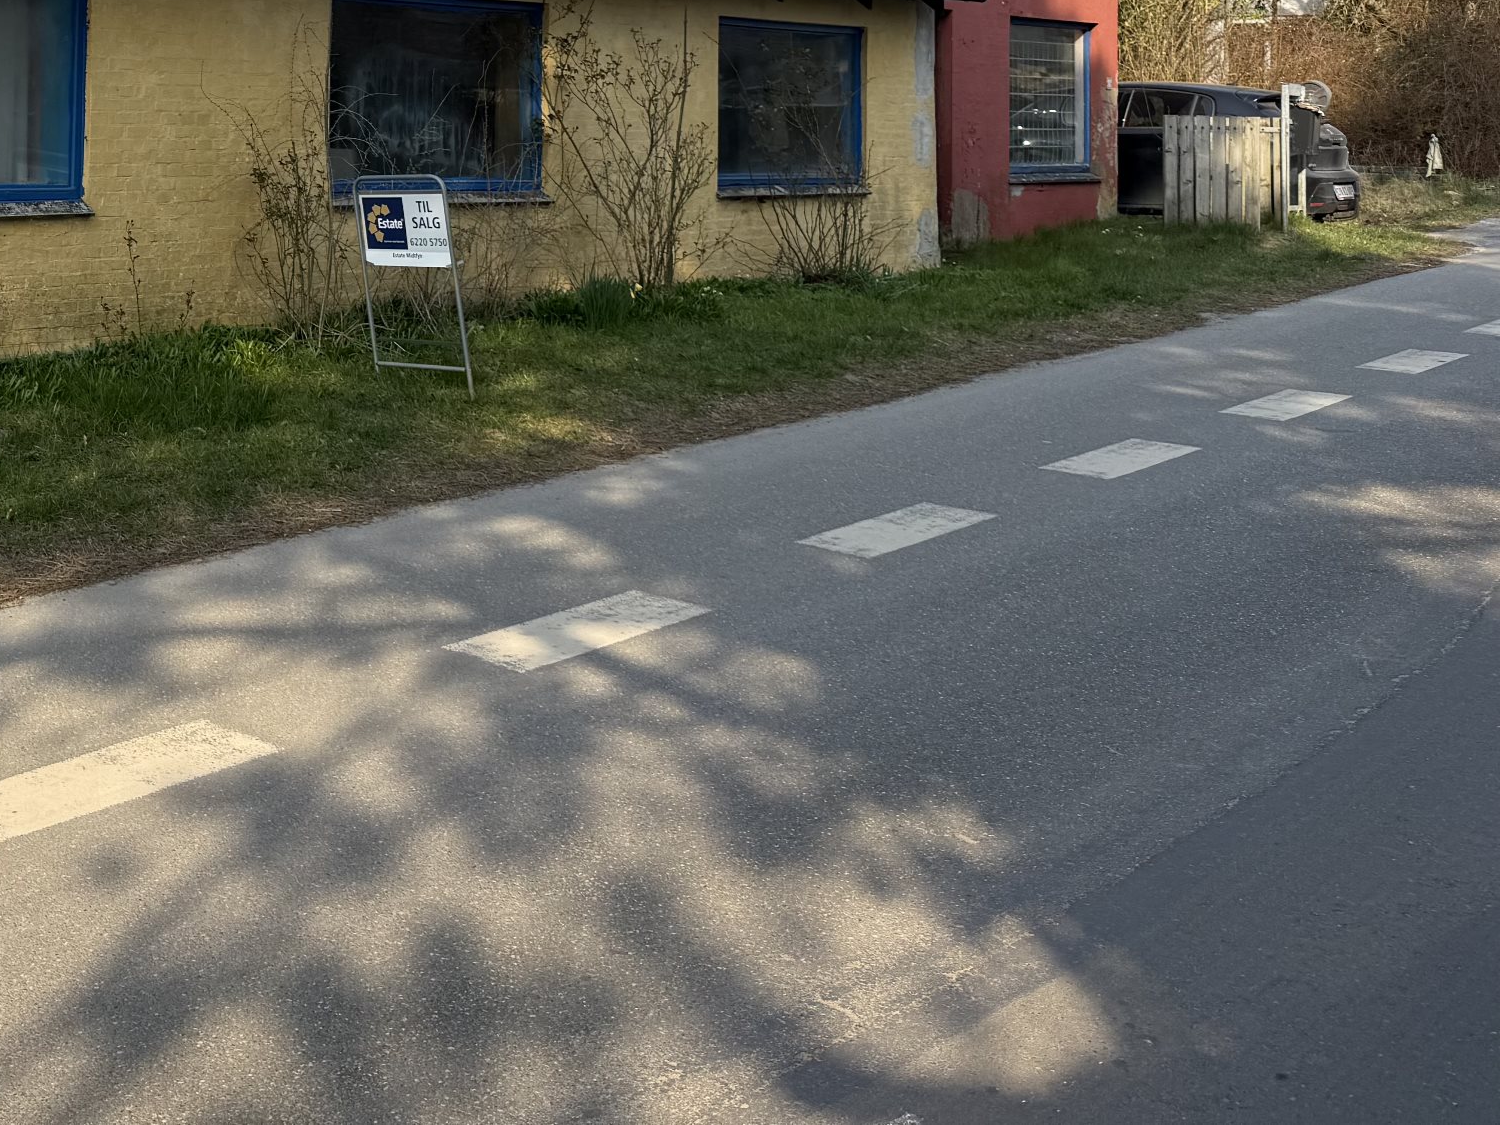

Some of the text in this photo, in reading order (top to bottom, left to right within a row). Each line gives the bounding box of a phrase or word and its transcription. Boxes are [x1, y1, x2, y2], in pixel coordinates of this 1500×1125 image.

[415, 200, 433, 213] TIL
[377, 217, 403, 229] Estate
[411, 216, 441, 229] SALG
[410, 238, 428, 247] 6220
[430, 238, 448, 247] 5750
